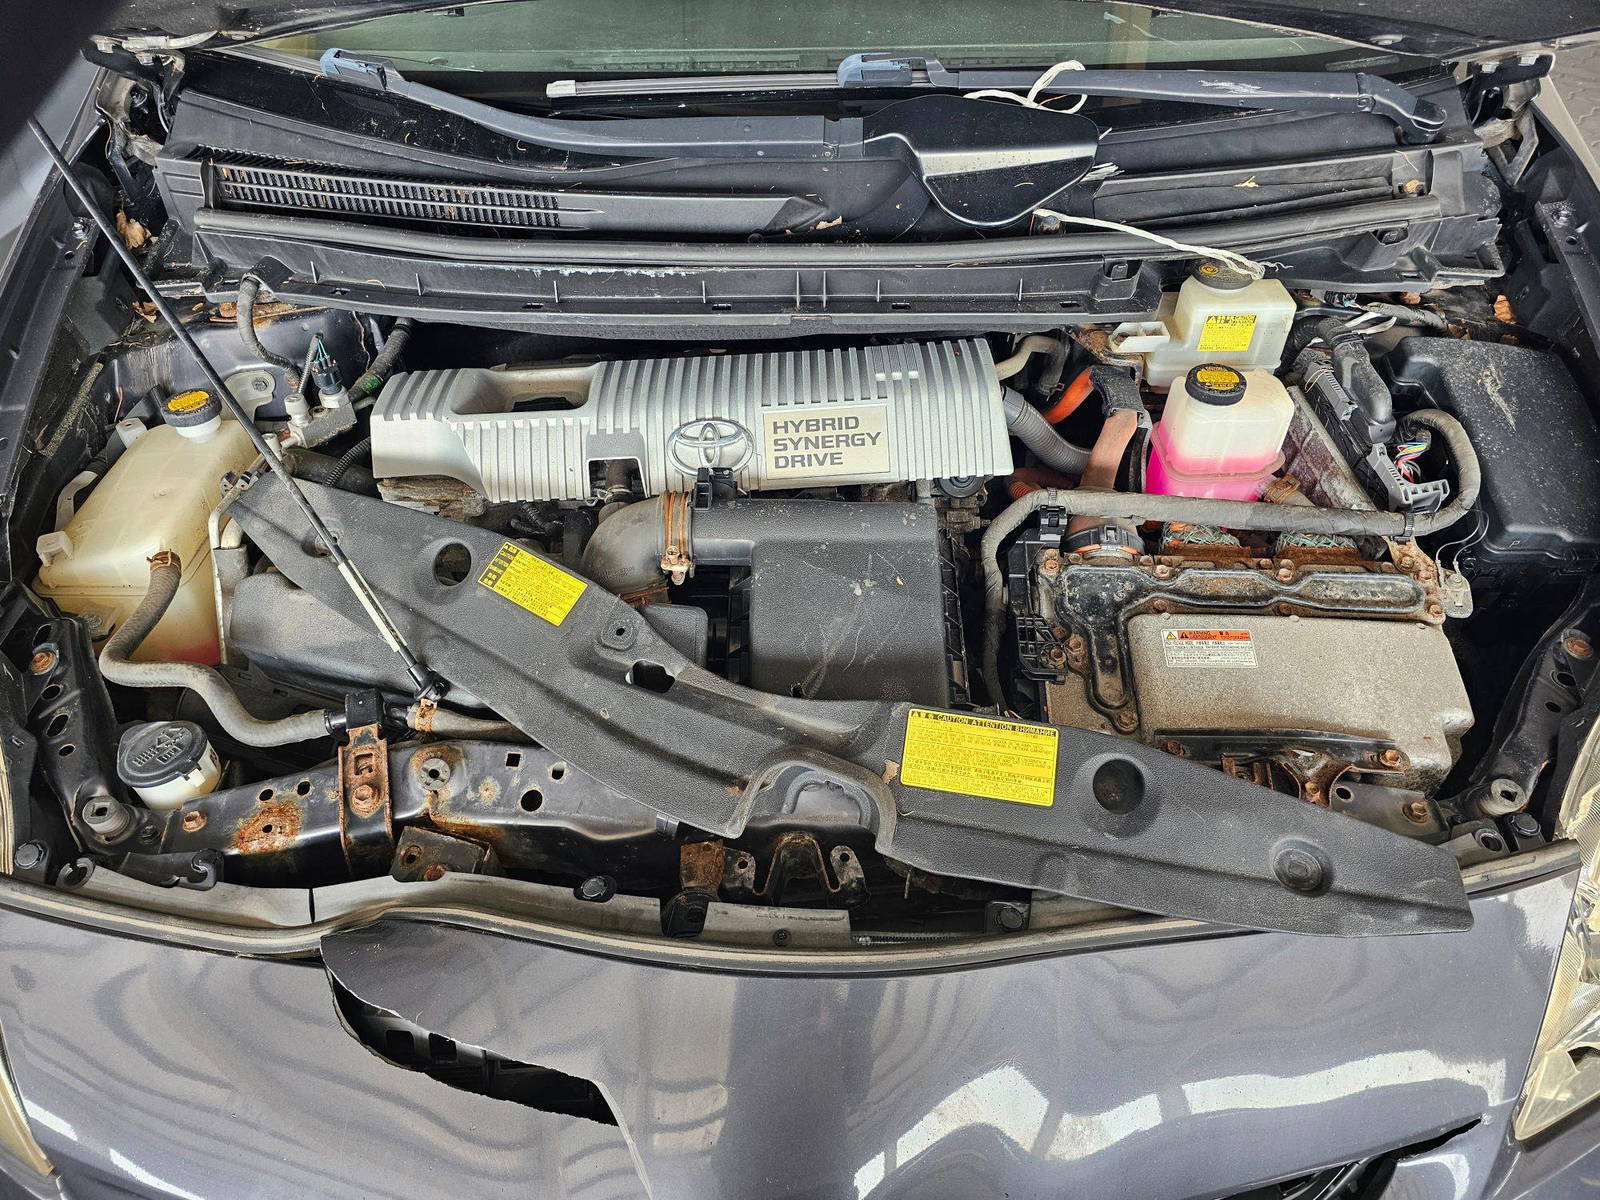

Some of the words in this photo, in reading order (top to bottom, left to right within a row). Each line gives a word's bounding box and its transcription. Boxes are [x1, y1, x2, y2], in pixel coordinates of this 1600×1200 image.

[773, 416, 859, 434] HYBRID
[774, 432, 881, 452] SYNERGY
[774, 452, 844, 469] DRIVE
[937, 715, 969, 725] CAUTION
[972, 719, 1013, 731] ATTENTION
[1015, 725, 1055, 737] ВНИМАНИЕ
